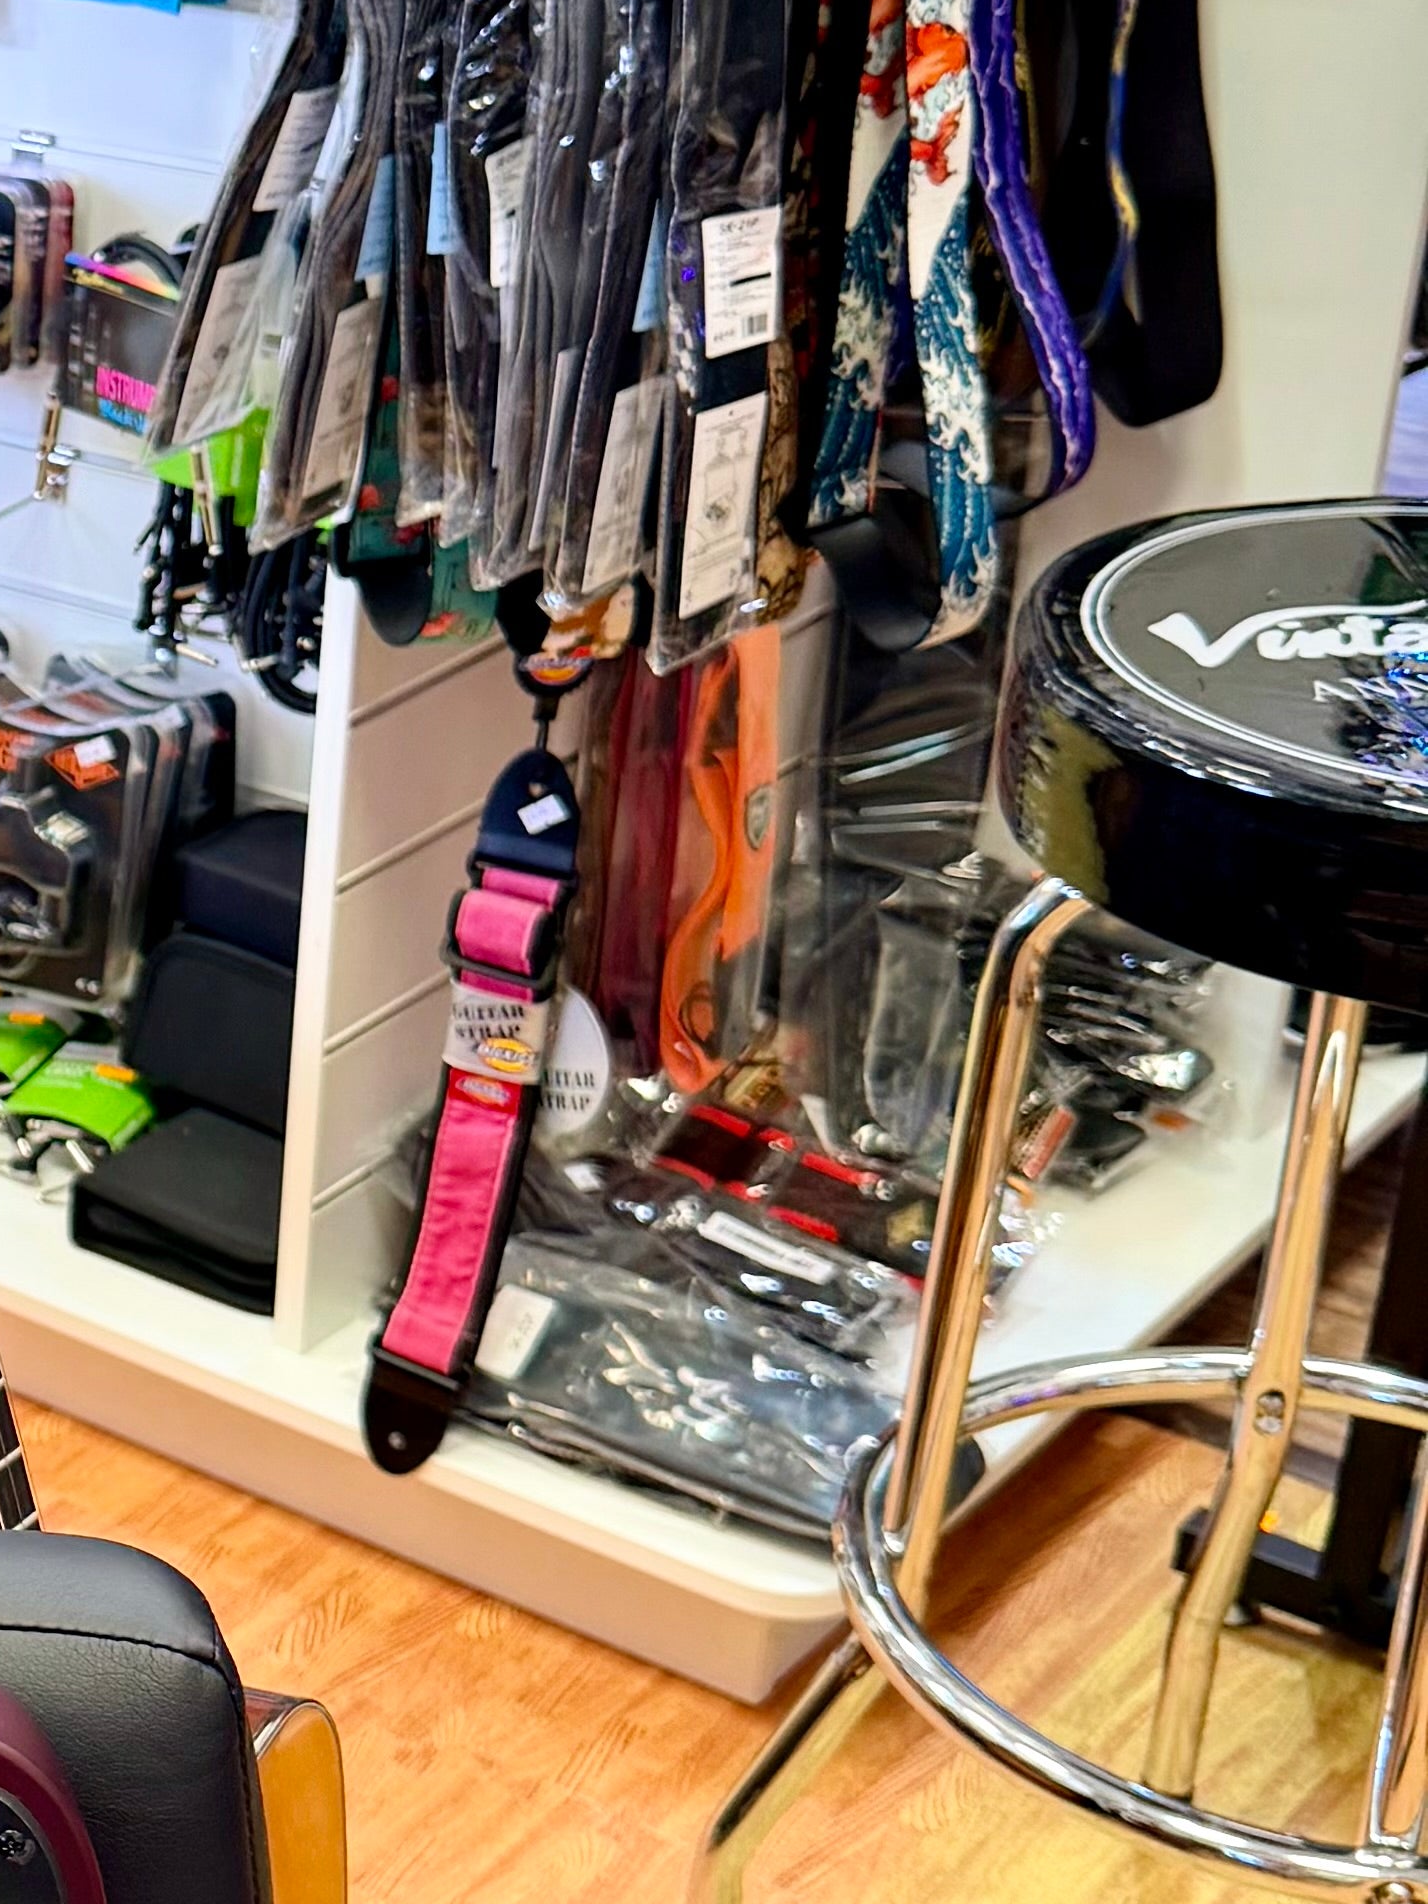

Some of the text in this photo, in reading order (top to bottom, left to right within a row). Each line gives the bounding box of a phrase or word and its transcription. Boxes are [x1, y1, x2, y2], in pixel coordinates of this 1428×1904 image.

[1147, 599, 1428, 668] Vinta
[452, 1004, 525, 1021] GUITAR
[544, 1070, 595, 1088] UITAR
[539, 1094, 586, 1111] TRAP
